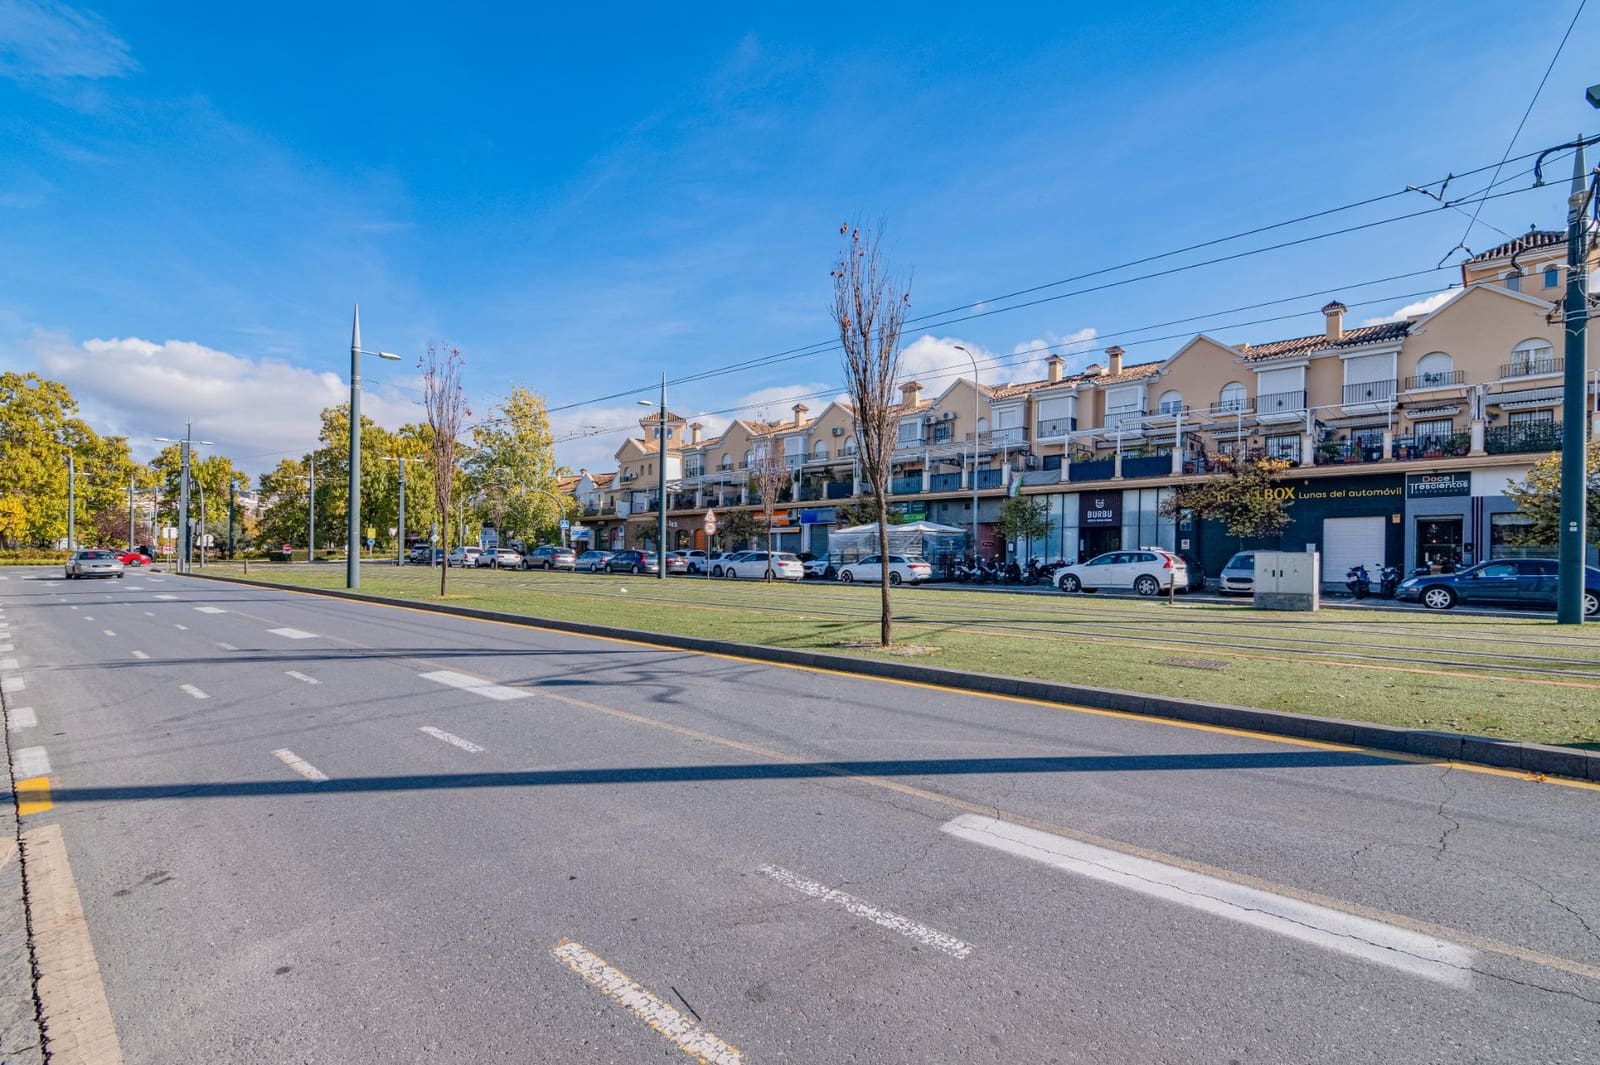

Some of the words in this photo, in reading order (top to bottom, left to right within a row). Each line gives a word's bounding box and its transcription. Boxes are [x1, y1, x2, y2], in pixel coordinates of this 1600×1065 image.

[1422, 475, 1450, 483] Doce
[1264, 487, 1296, 500] BOX
[1298, 491, 1327, 499] Lunas
[1329, 489, 1346, 498] del
[1348, 487, 1402, 497] automóvil
[1087, 509, 1113, 519] BURBU
